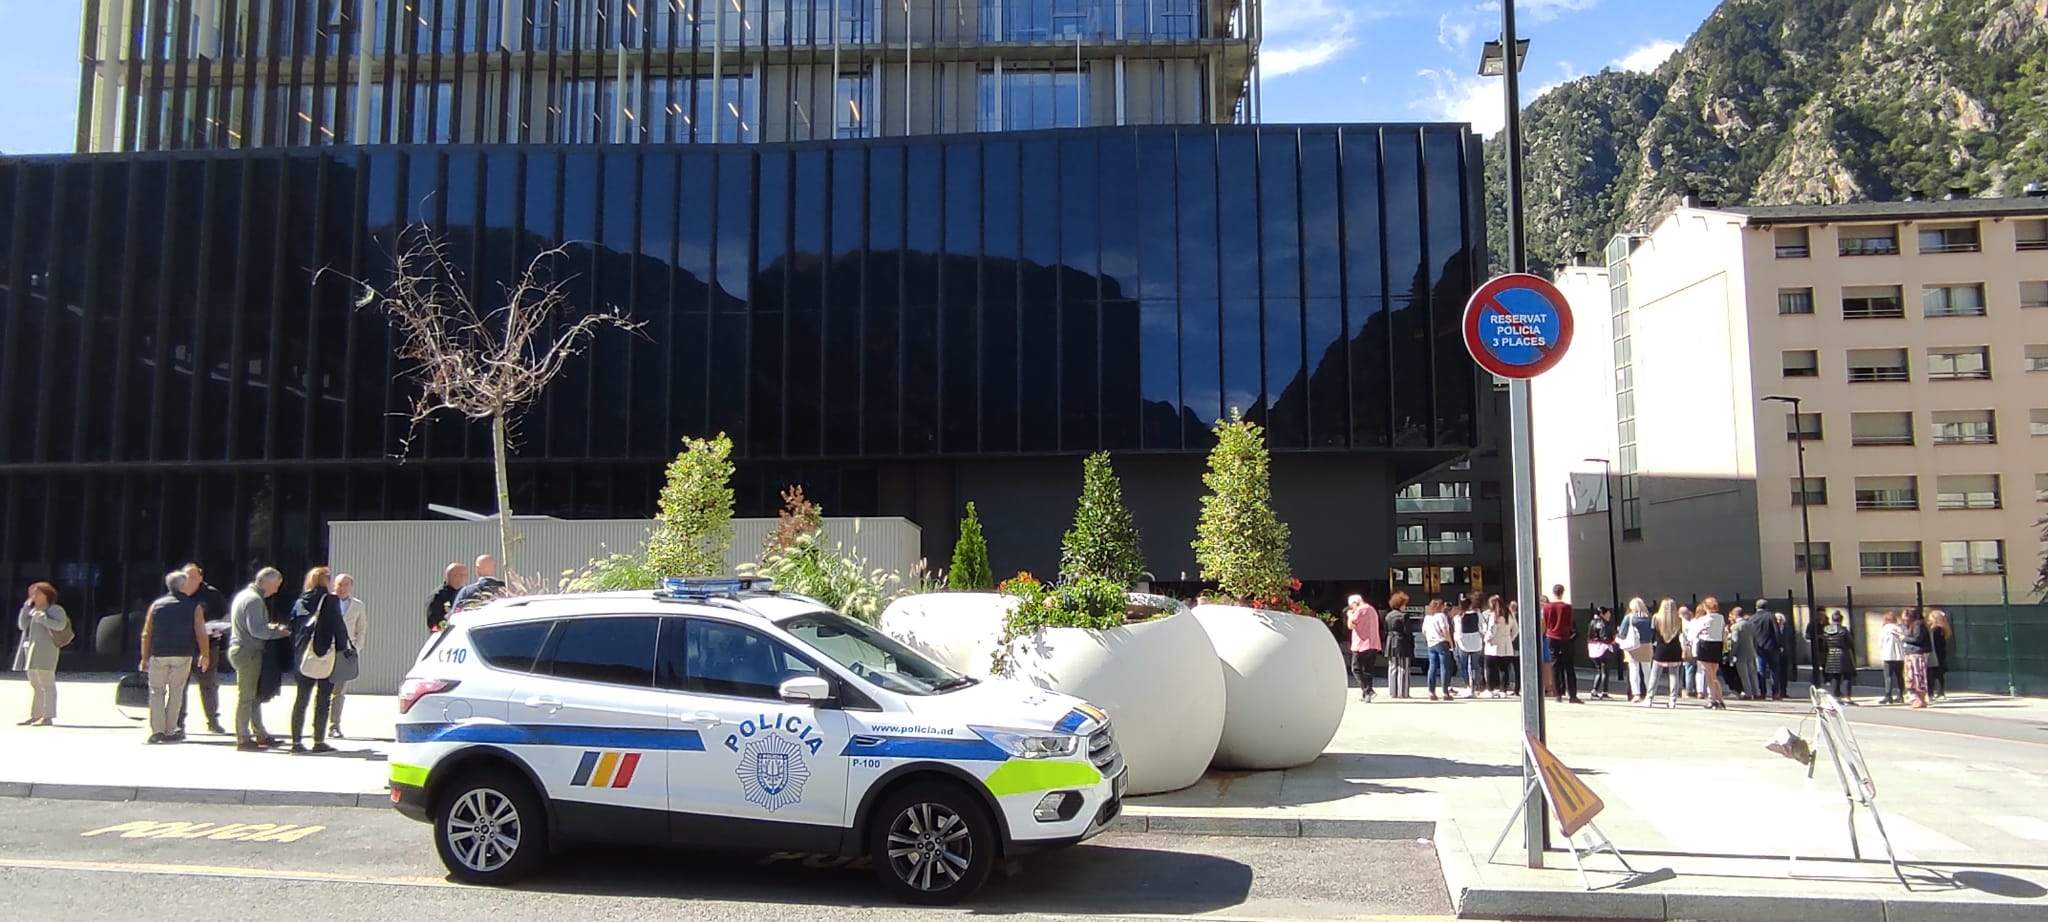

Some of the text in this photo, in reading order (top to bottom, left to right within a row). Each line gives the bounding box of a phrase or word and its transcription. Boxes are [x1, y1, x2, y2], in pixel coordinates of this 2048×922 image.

[1490, 314, 1547, 324] RESERVAT
[1497, 326, 1541, 335] POLICIA
[1493, 337, 1546, 347] 3 PLACES
[446, 648, 467, 664] 110
[724, 713, 823, 756] POLICIA
[871, 724, 954, 736] www.policia.ad
[853, 759, 880, 768] P-100
[80, 820, 326, 843] POLICIA
